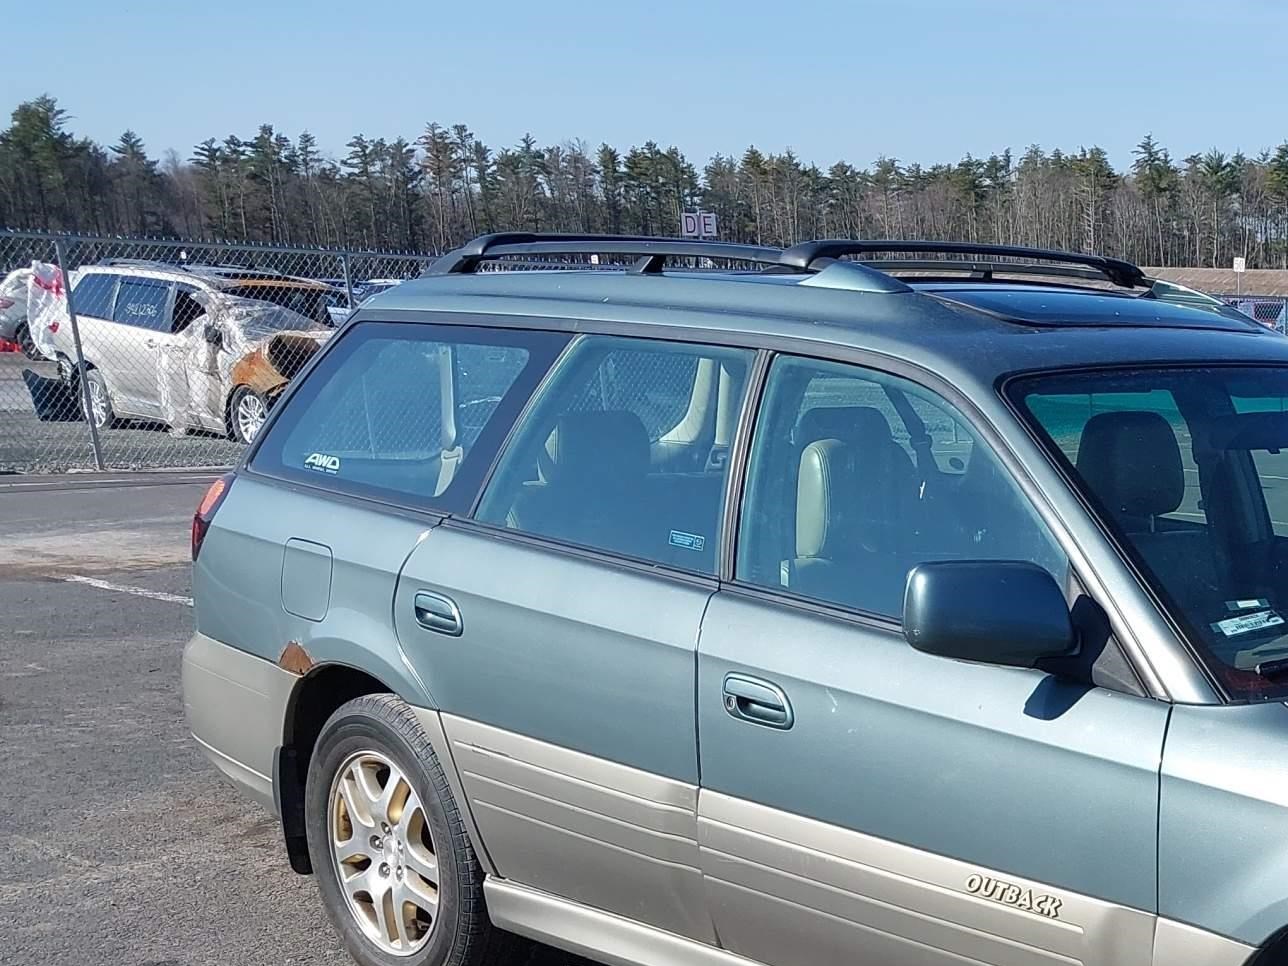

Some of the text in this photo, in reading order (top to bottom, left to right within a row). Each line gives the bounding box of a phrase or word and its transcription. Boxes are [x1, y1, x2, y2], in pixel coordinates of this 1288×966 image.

[685, 215, 696, 233] D
[703, 216, 713, 233] E
[305, 453, 340, 470] AWD
[966, 874, 1062, 918] OUTBACK
